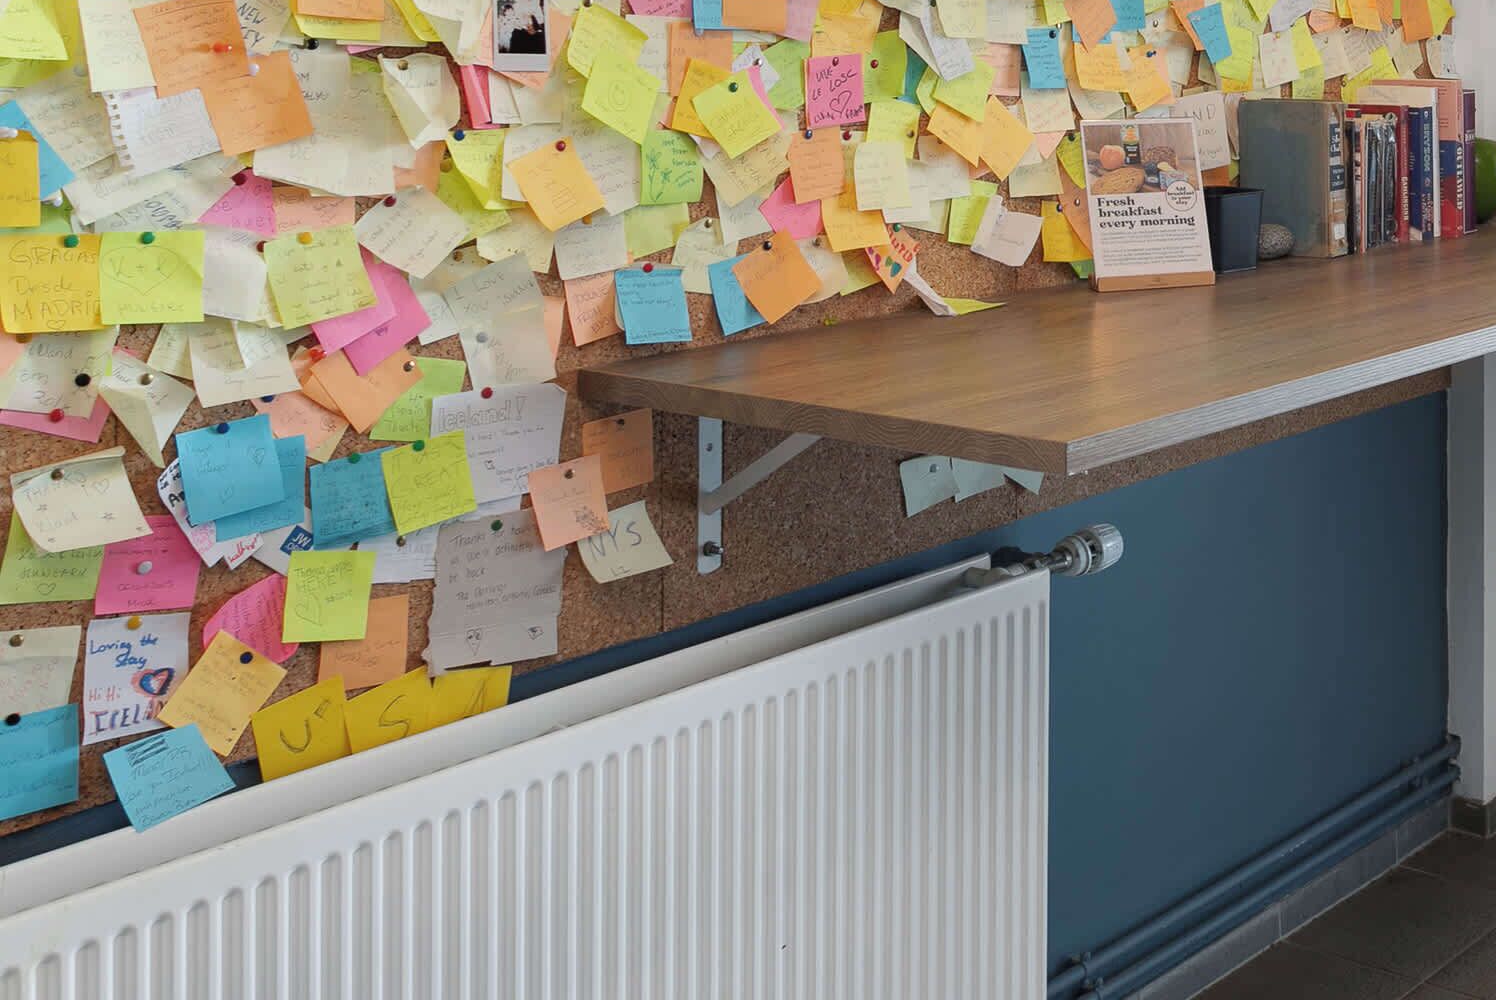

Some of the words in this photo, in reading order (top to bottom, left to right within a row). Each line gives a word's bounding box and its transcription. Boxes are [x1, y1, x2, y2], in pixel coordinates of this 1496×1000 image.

[1096, 196, 1136, 208] Fresh
[1098, 205, 1163, 218] breakfast
[1099, 219, 1137, 230] every
[1140, 214, 1197, 227] morning
[292, 532, 312, 546] JW
[90, 639, 133, 657] Loving
[139, 633, 159, 647] the
